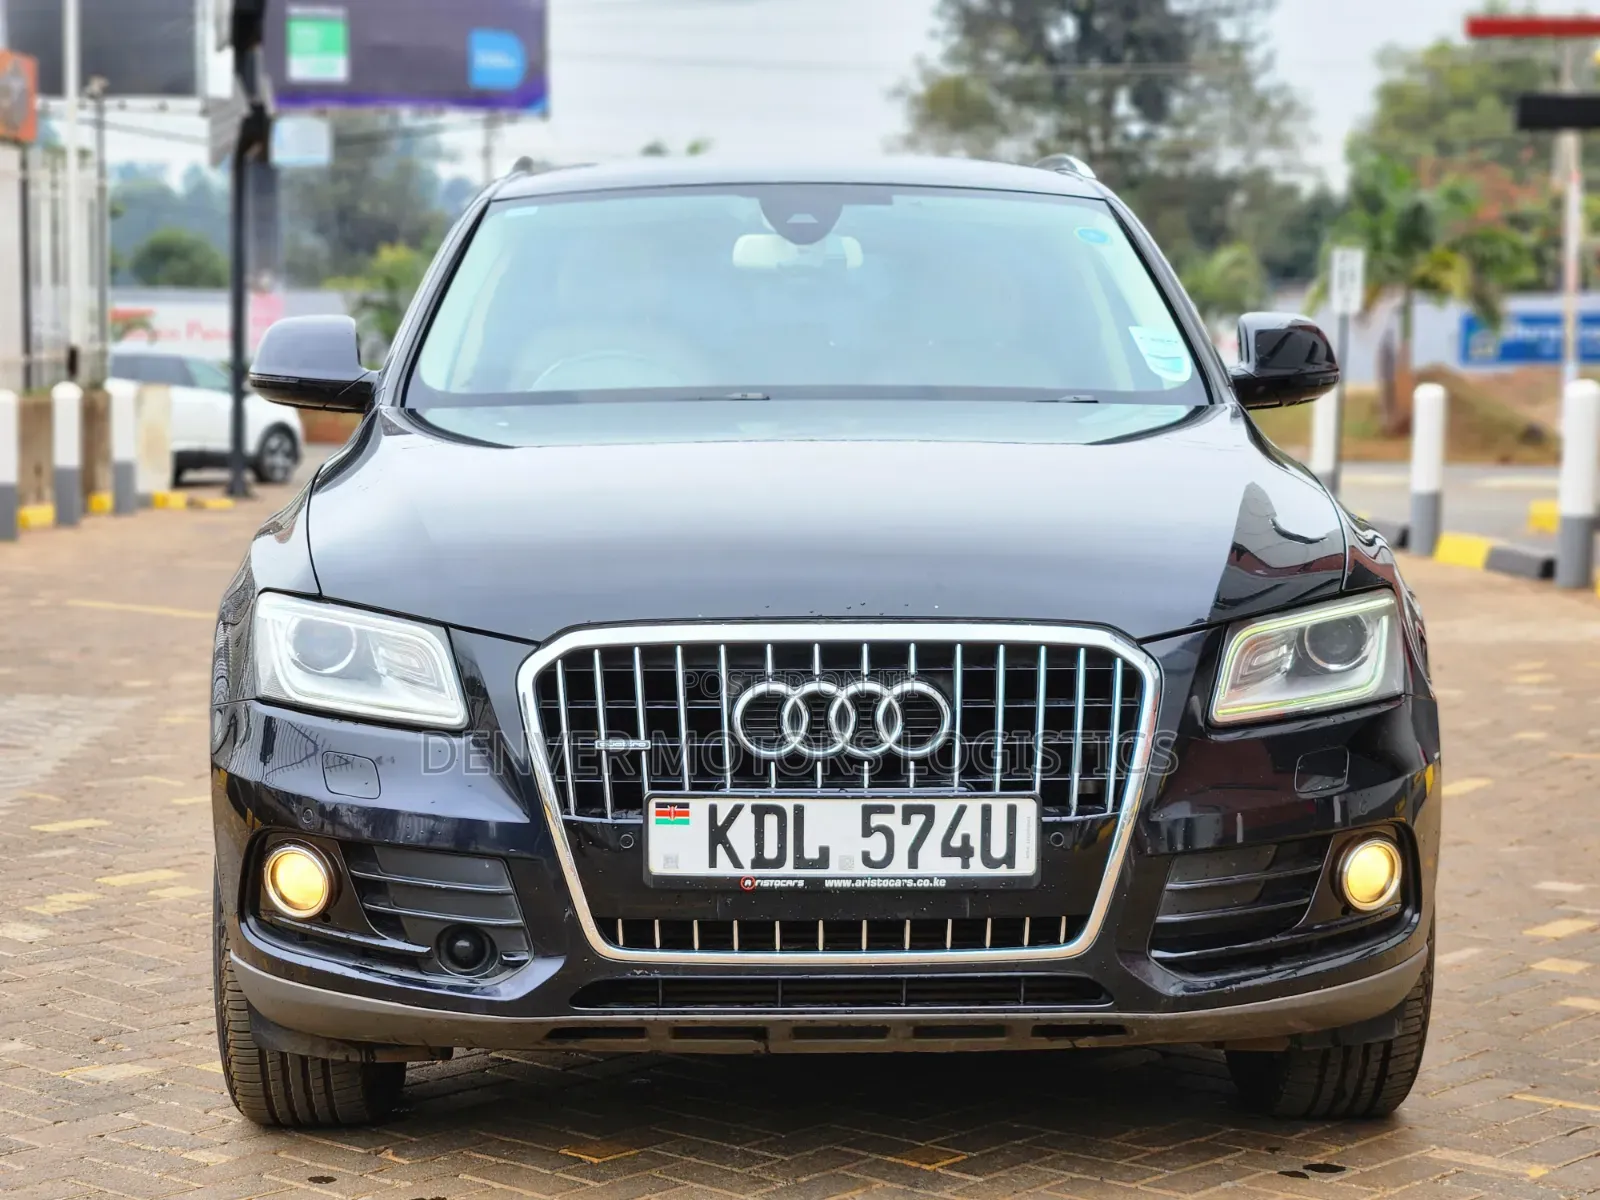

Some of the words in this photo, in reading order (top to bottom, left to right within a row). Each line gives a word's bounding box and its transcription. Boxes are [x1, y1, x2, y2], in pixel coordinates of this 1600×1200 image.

[707, 803, 831, 870] KDL
[860, 803, 1017, 870] 574U
[825, 877, 947, 887] www.aristocars.co.ke
